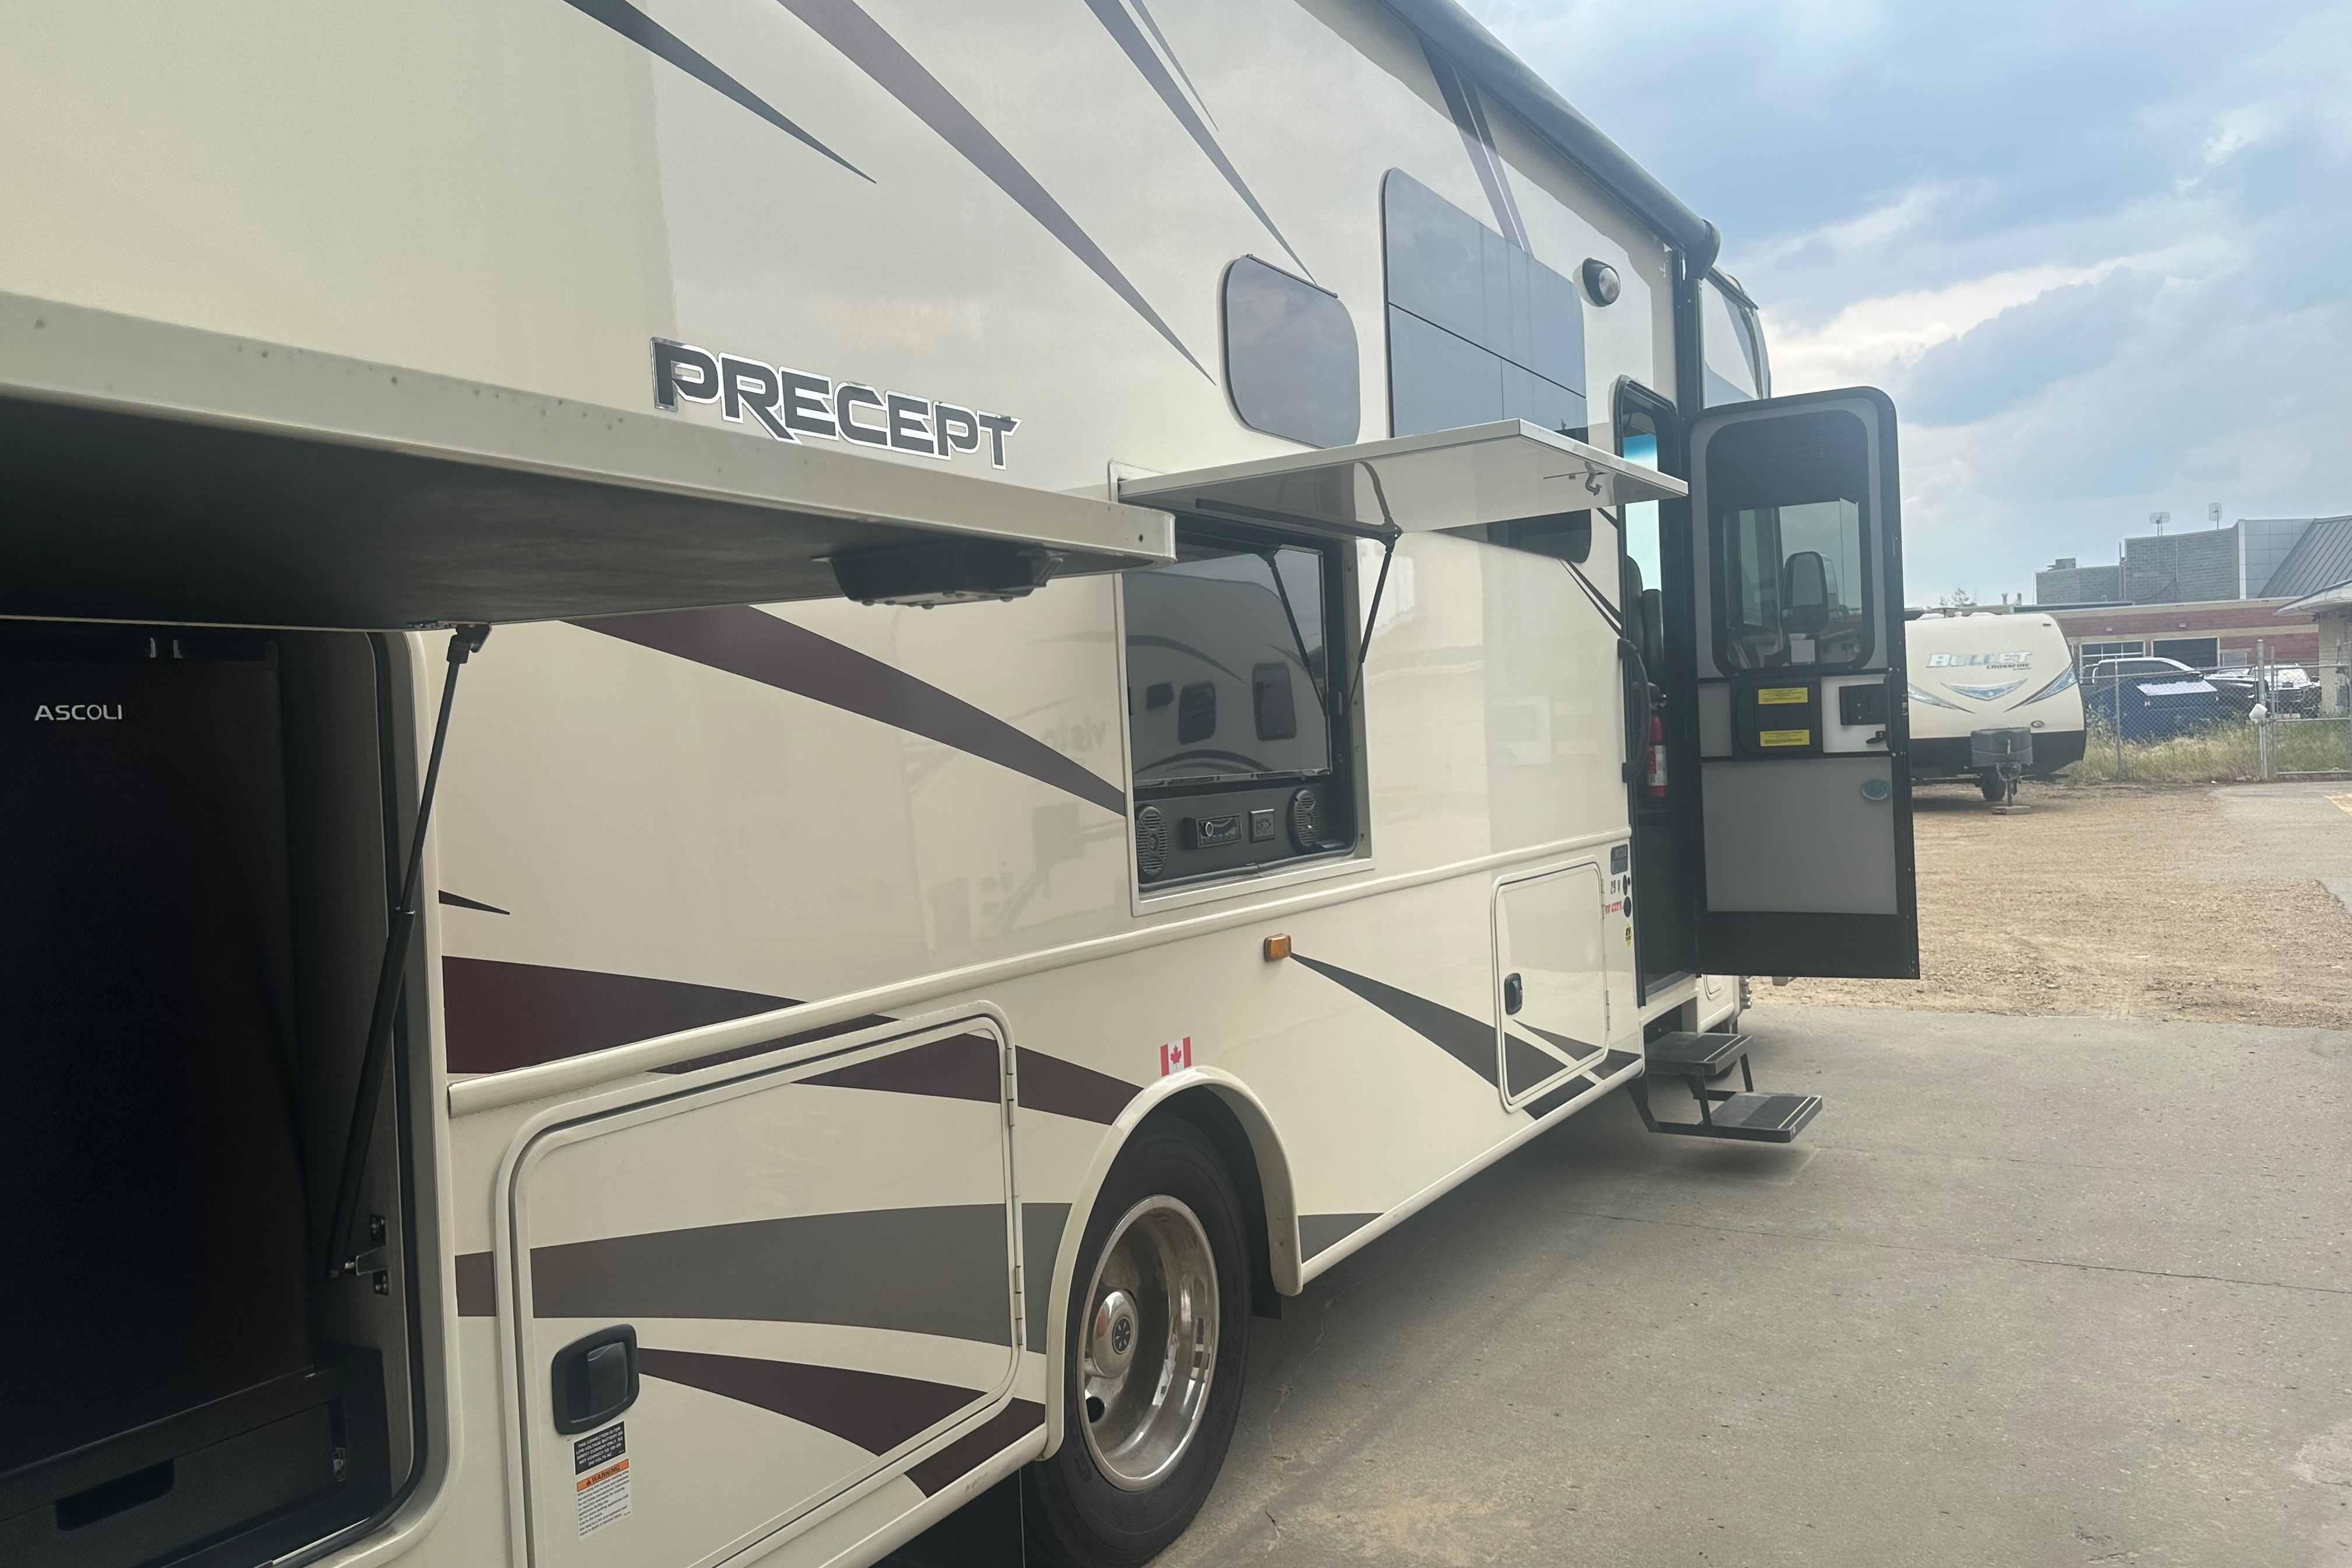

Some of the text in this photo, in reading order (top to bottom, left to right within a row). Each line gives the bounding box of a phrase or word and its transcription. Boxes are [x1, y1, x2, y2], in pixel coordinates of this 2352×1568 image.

[650, 337, 1023, 470] PRECEPT
[1926, 652, 2032, 667] BULLET
[34, 705, 123, 721] ASCOLI
[592, 1465, 620, 1483] WARNING
